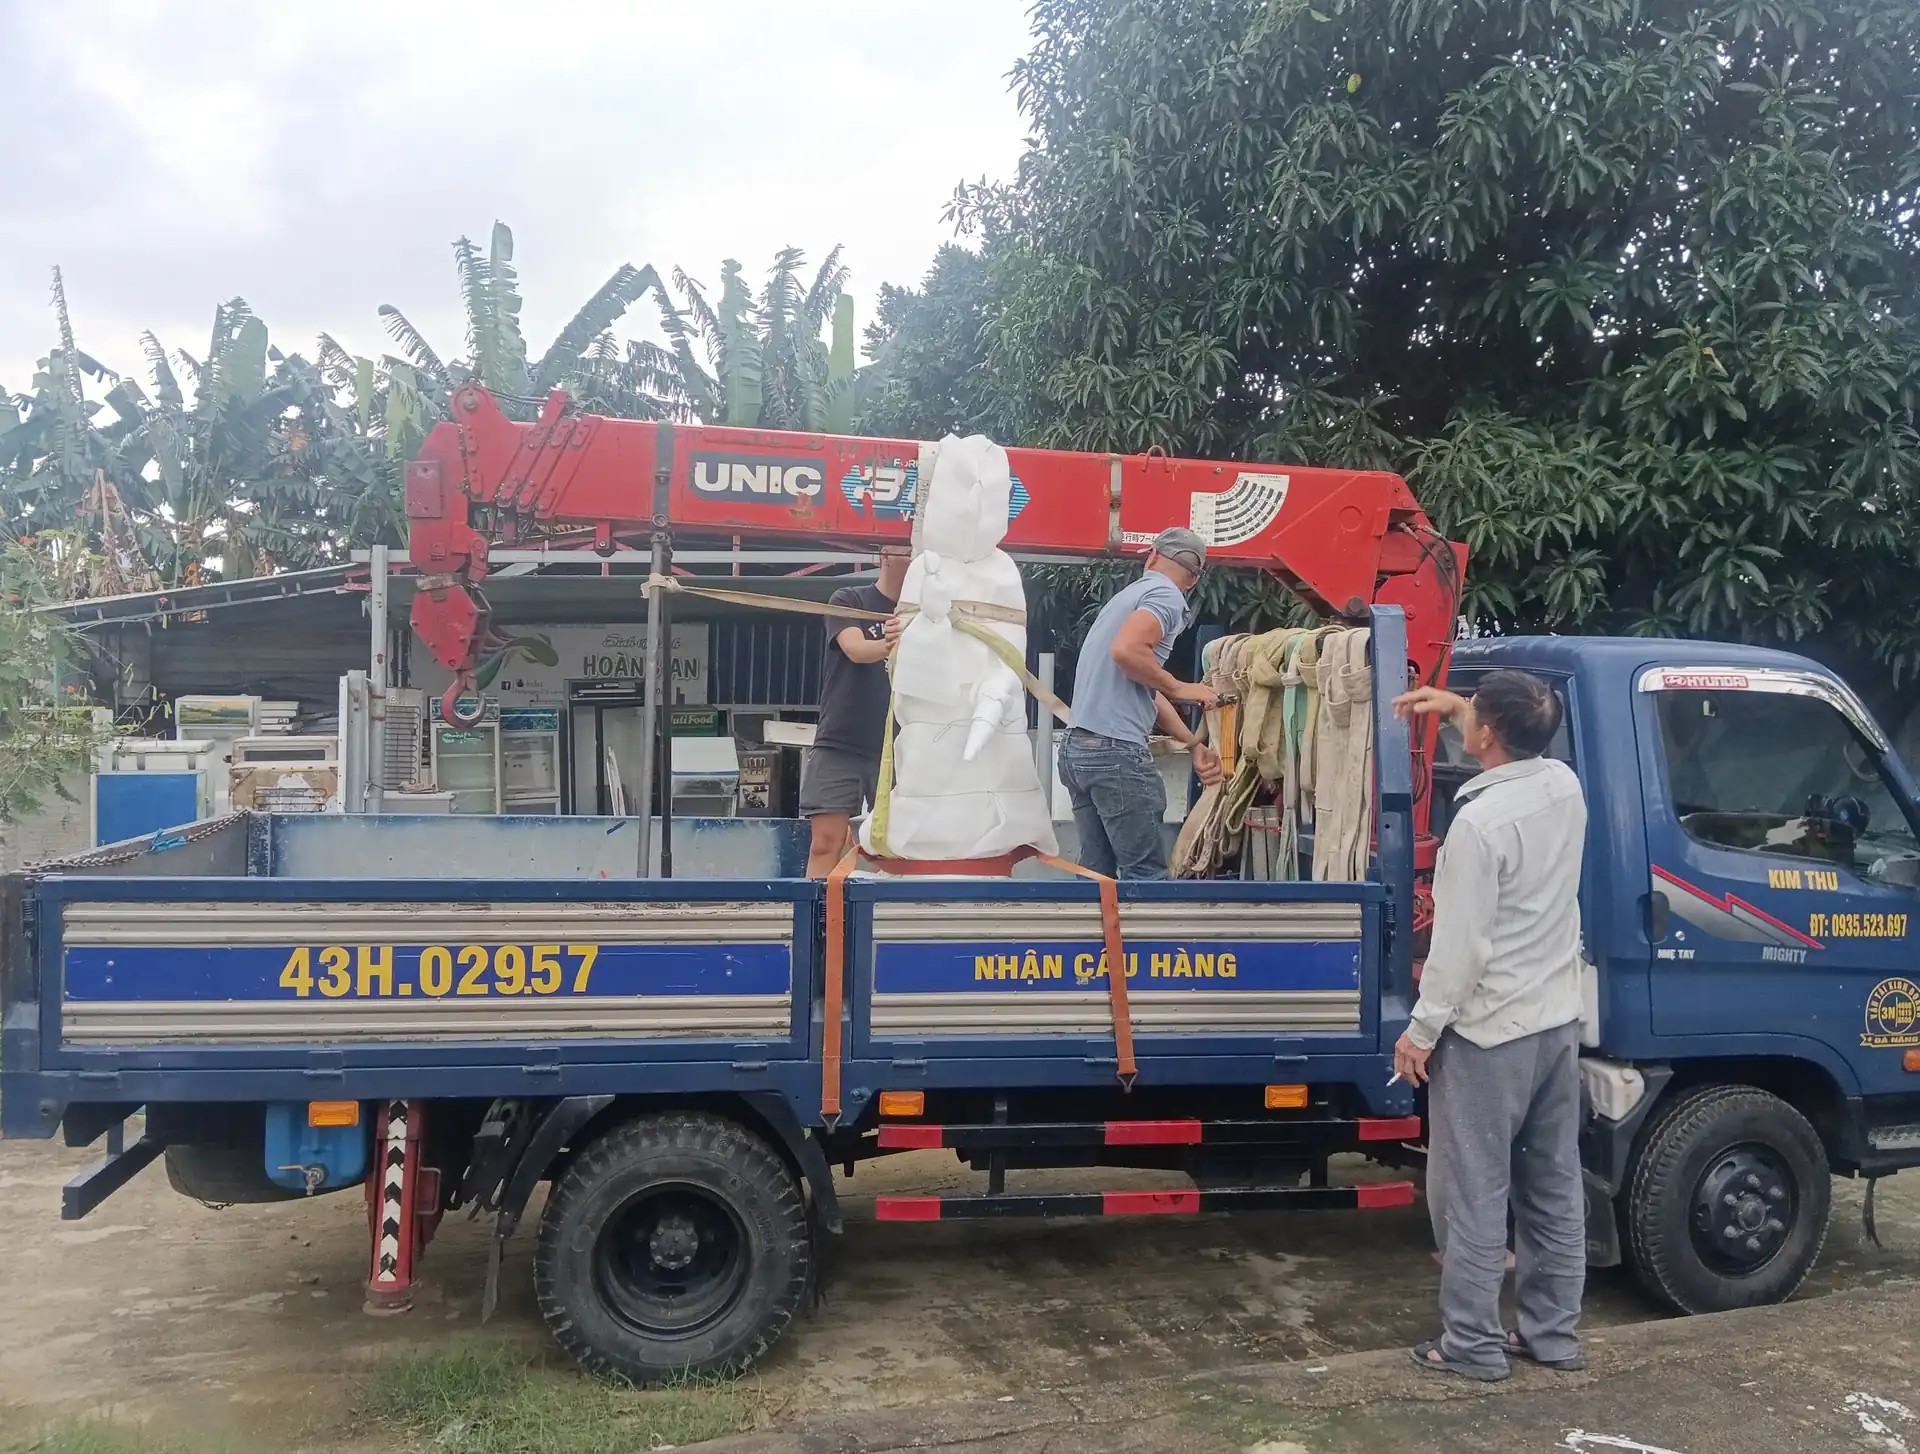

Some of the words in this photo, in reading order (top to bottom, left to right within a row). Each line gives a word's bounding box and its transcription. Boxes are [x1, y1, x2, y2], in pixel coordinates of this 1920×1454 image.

[694, 461, 822, 496] UNIC
[583, 652, 661, 678] HOÀN
[670, 657, 698, 679] AN
[1687, 676, 1746, 688] HYUNDAI
[672, 713, 715, 725] utiFood
[1768, 868, 1802, 889] KIM
[1804, 870, 1839, 891] THU
[1832, 913, 1907, 937] 0935.523.697
[1677, 949, 1696, 960] TAY
[1762, 946, 1808, 964] MIGHTY
[975, 948, 1063, 985] NHẬN
[1150, 947, 1237, 978] HÀNG
[1881, 1006, 1896, 1020] 3N
